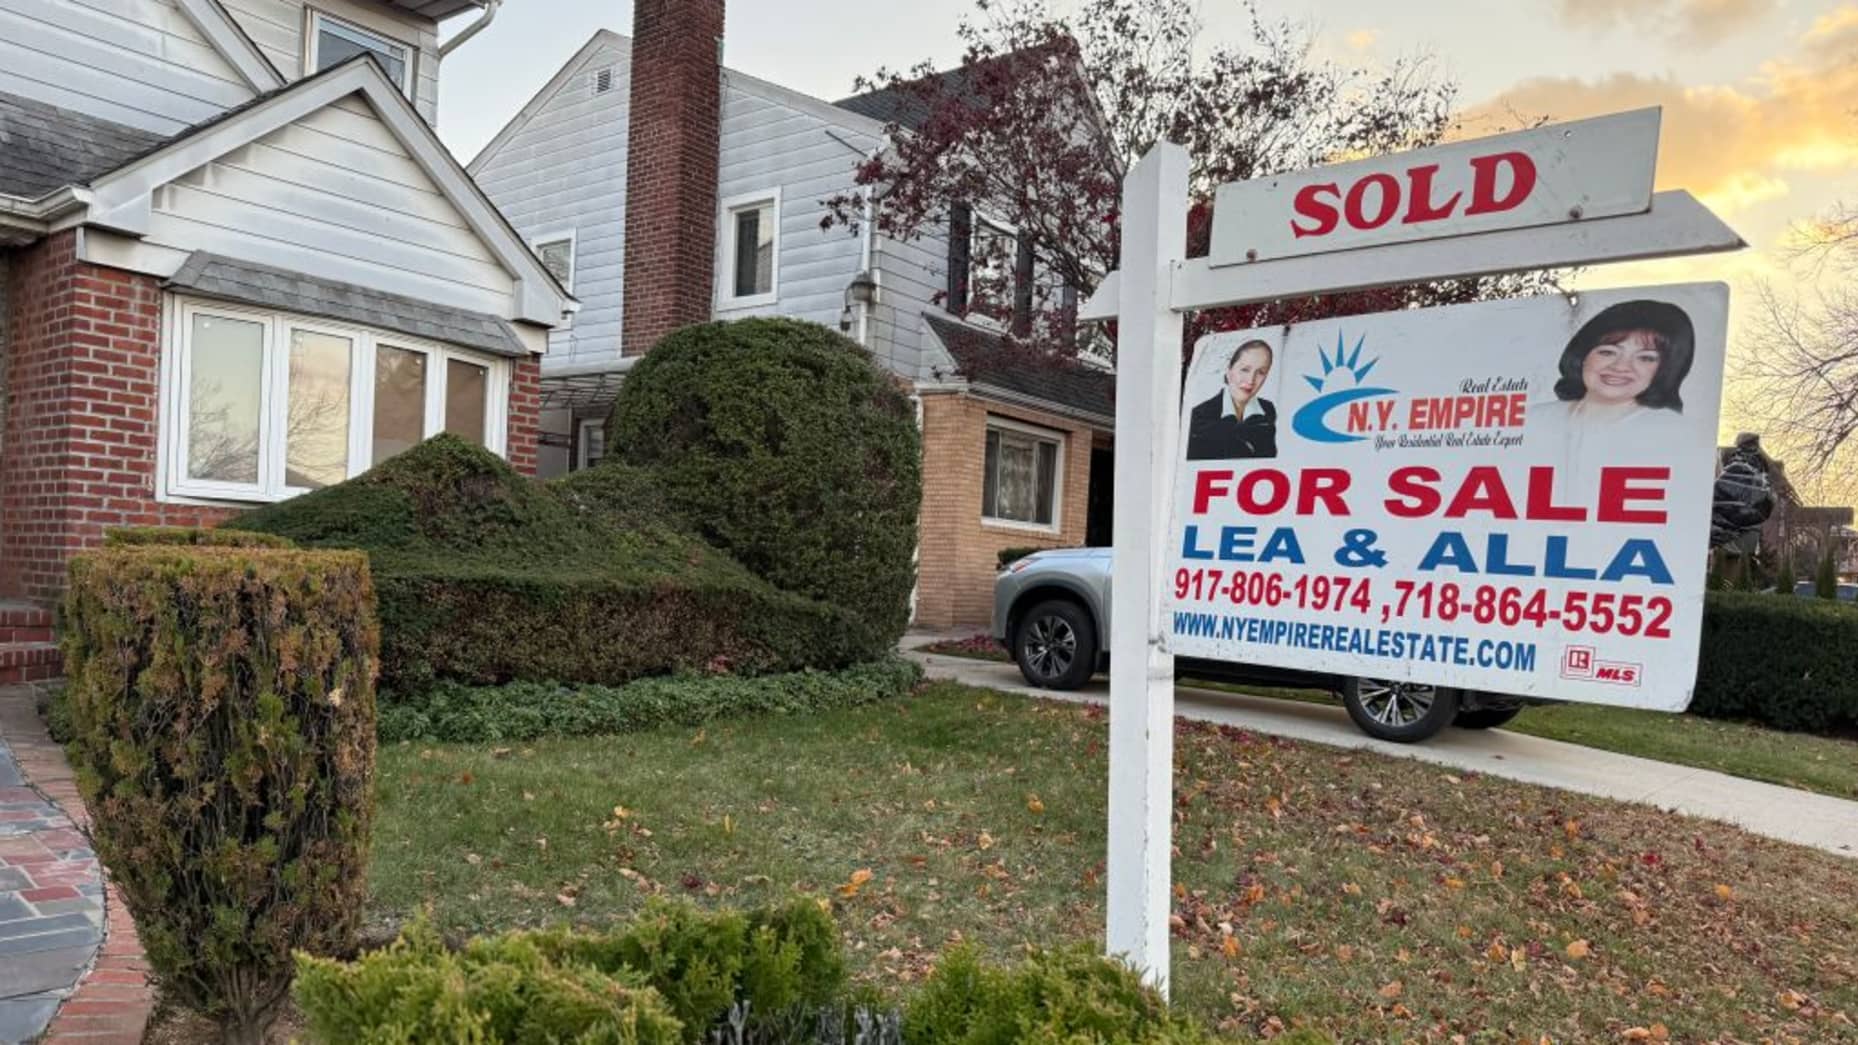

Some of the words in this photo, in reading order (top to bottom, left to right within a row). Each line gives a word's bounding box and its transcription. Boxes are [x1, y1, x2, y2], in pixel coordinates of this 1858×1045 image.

[1290, 152, 1537, 239] SOLD
[1458, 375, 1491, 394] Real
[1348, 400, 1398, 432] N.Y.
[1407, 393, 1528, 431] EMPIRE
[1374, 434, 1396, 452] Your
[1399, 432, 1443, 448] Residential
[1445, 432, 1465, 447] Real
[1466, 431, 1491, 447] Estate
[1493, 430, 1524, 450] Expert
[1193, 467, 1352, 517] FOR
[1384, 466, 1671, 524] SALE
[1180, 523, 1306, 567] LEA
[1333, 527, 1389, 571] &
[1415, 530, 1675, 588] ALLA
[1175, 567, 1371, 615] 917-806-1974
[1173, 611, 1537, 673] WWW.NYEMPIREREALESTATE.COM
[1596, 667, 1635, 682] MLS
